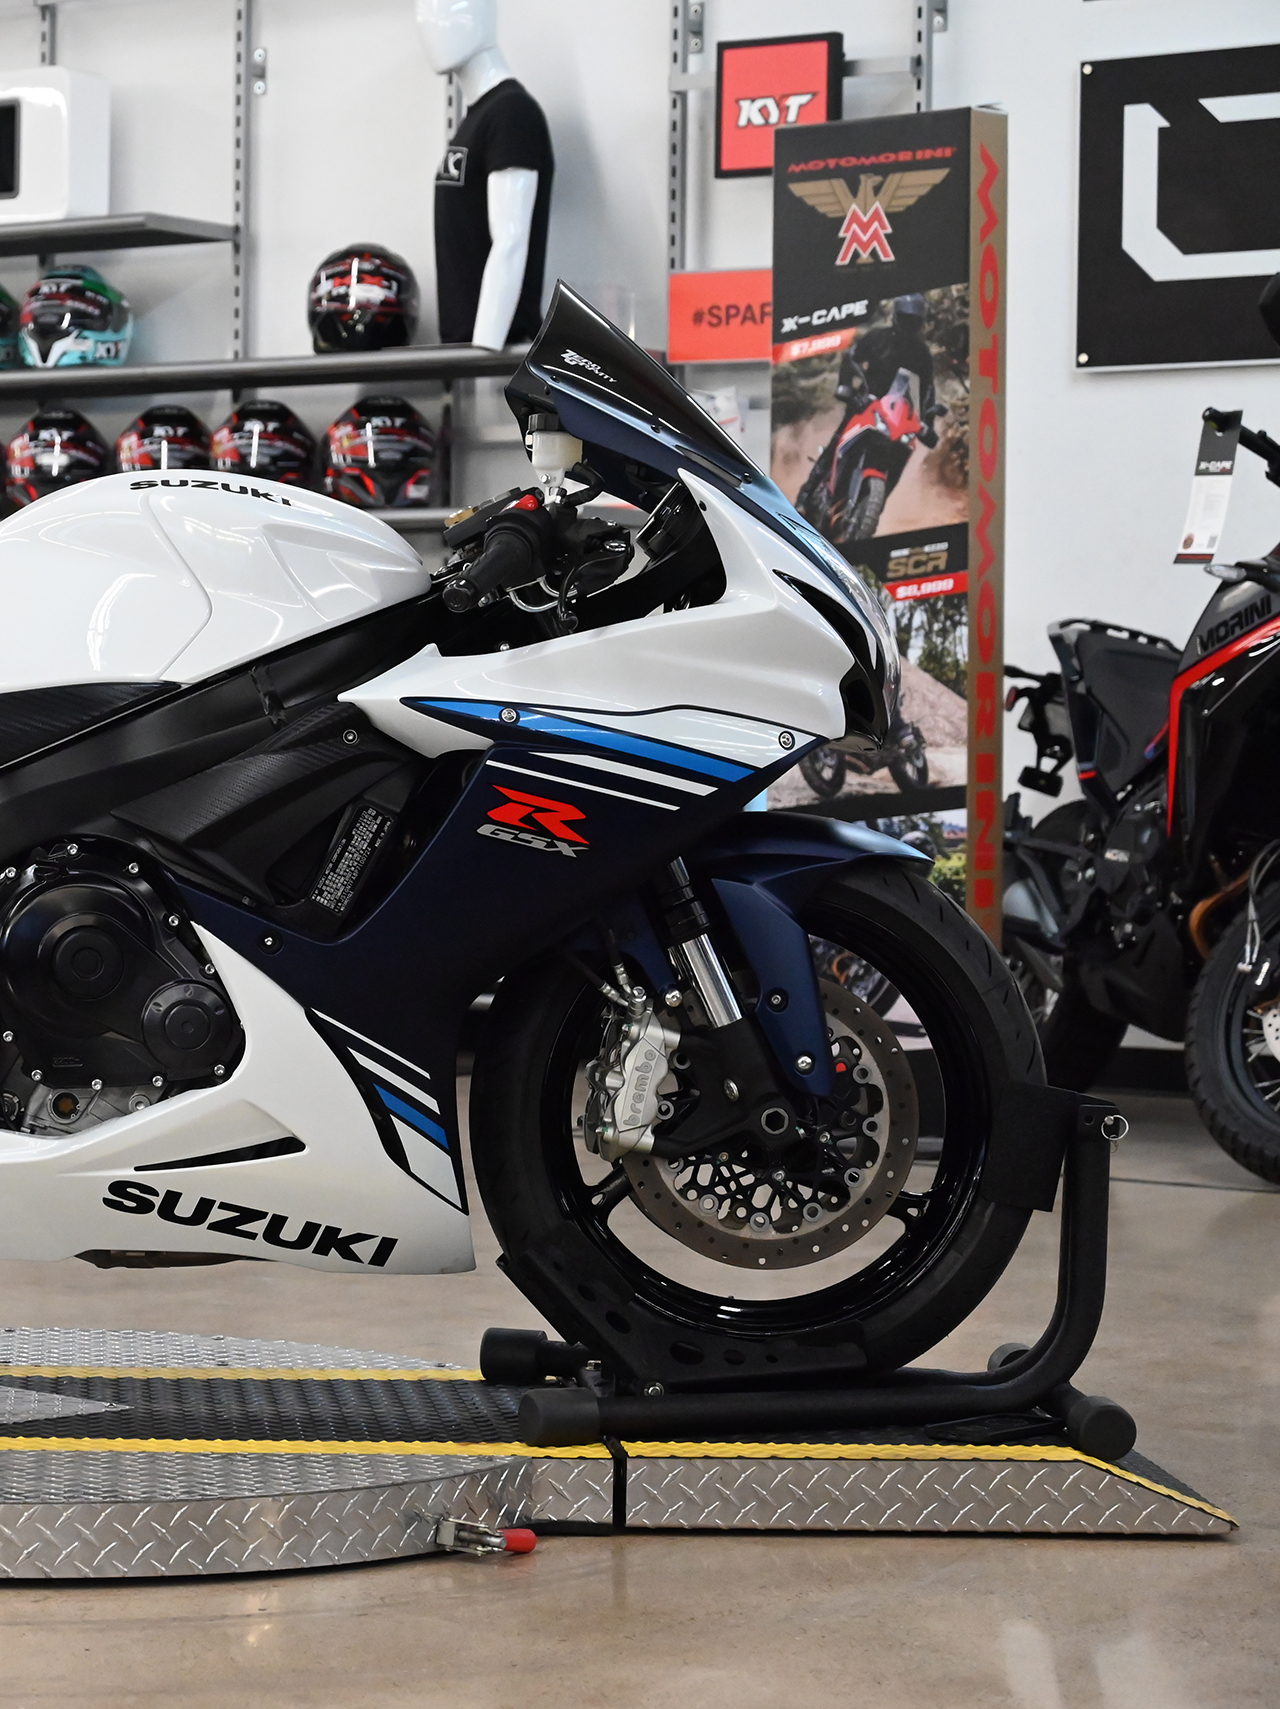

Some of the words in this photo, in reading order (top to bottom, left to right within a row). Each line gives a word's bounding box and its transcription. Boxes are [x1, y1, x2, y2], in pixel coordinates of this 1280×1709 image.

[736, 92, 818, 127] KYT
[781, 299, 868, 333] X-CAPE
[130, 480, 292, 506] SUZUKI
[1196, 594, 1272, 653] MORINI
[477, 824, 589, 858] GSX
[623, 1049, 657, 1126] brembo
[102, 1180, 398, 1267] SUZUKI
